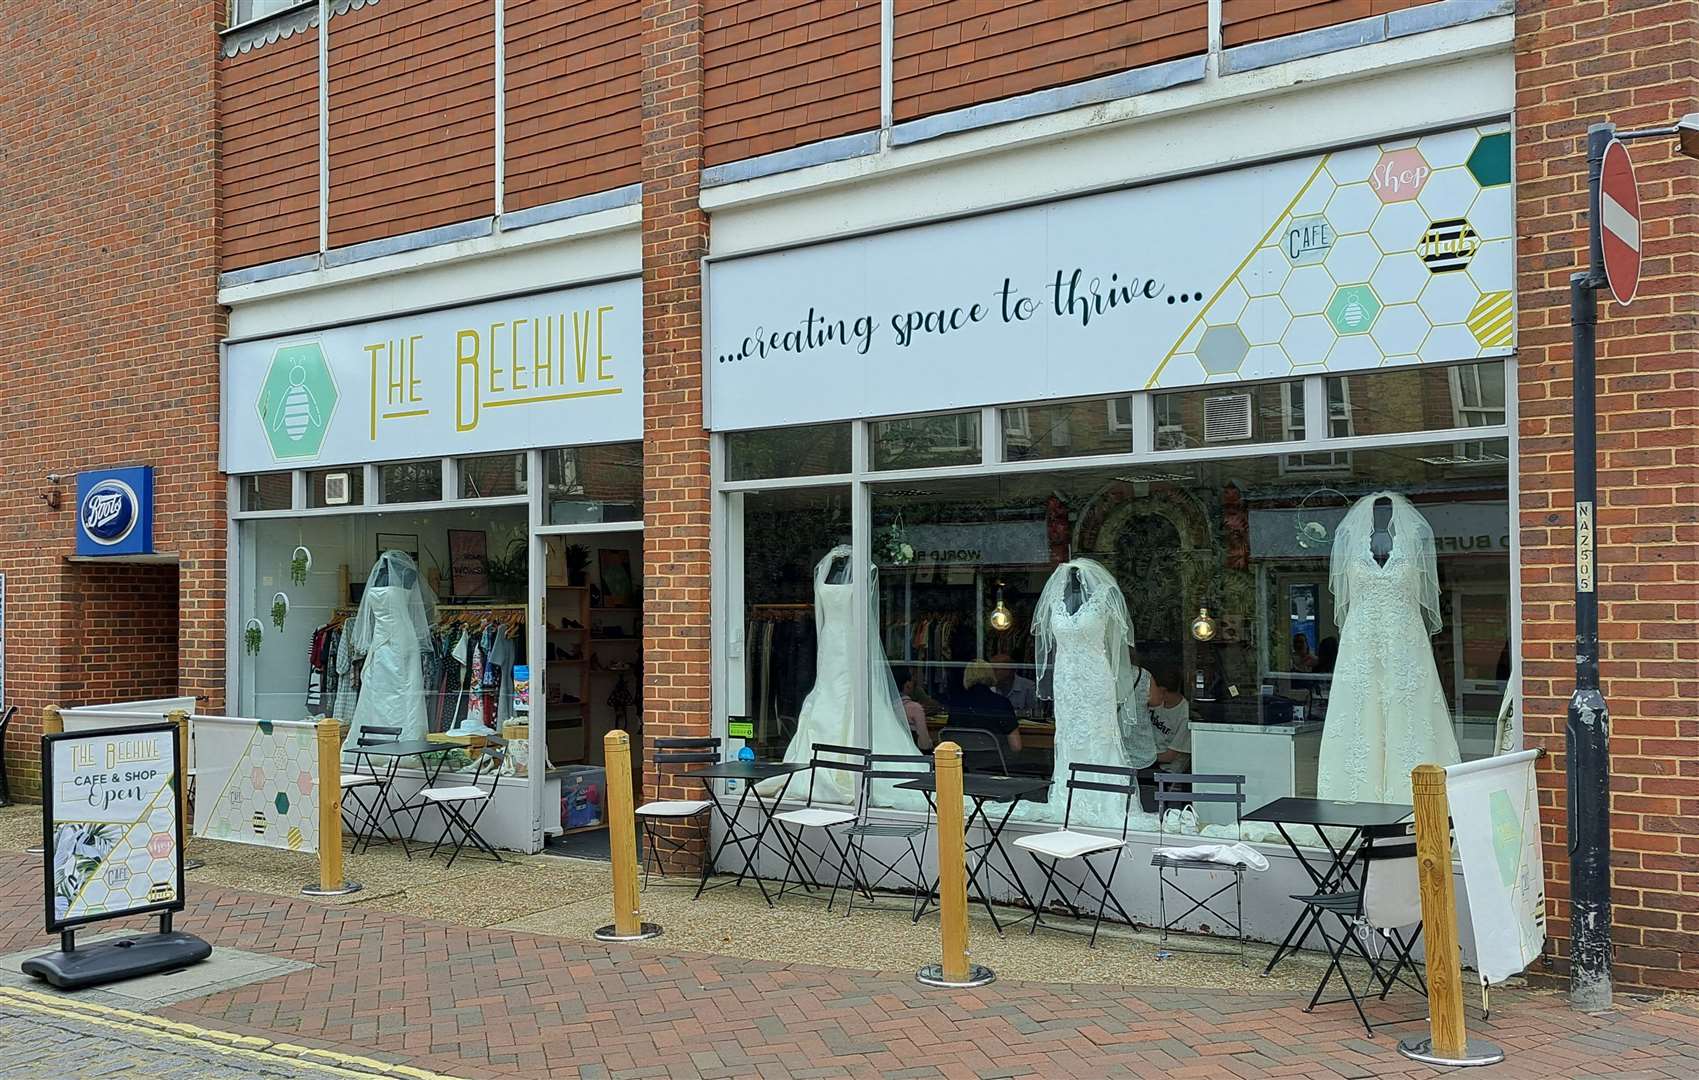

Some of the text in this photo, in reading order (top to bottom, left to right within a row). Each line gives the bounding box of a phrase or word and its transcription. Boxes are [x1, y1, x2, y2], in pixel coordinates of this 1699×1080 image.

[1372, 161, 1430, 193] Shop
[1289, 223, 1330, 259] CAFE
[1420, 224, 1476, 259] Hub
[892, 303, 988, 347] space
[993, 277, 1043, 323] to
[364, 306, 618, 441] THE BEEHIVE
[86, 493, 122, 528] Boots
[70, 739, 160, 772] THE BEEHIVE
[74, 770, 157, 786] CAFE & SHOP
[88, 783, 145, 811] Open
[108, 867, 127, 886] CAFE
